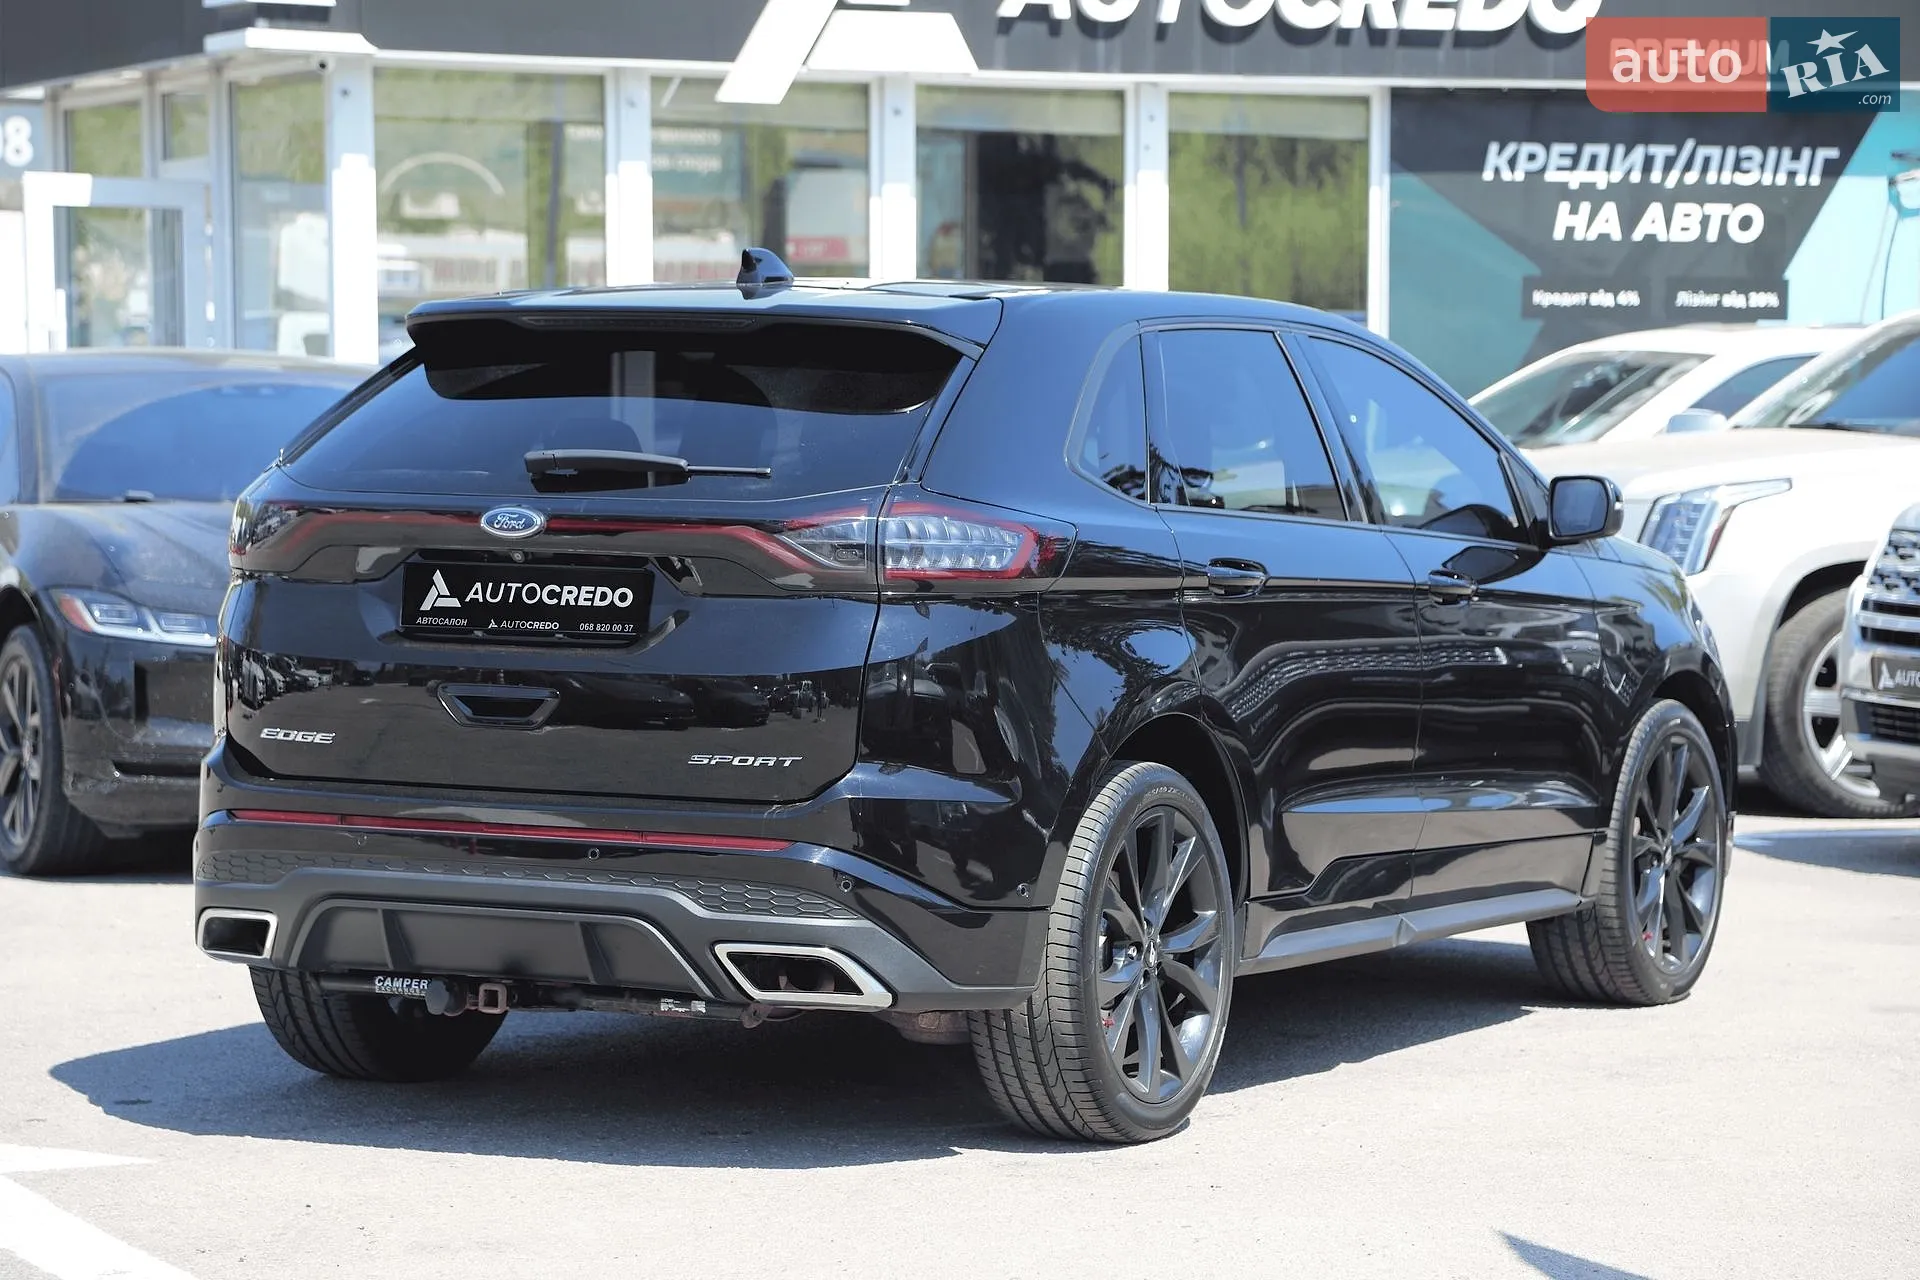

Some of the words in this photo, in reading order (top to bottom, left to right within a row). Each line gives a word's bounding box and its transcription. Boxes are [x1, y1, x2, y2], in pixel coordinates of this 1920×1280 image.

[1482, 138, 1841, 189] КРЕДИТ/ЛІЗІНГ
[1552, 201, 1623, 241] НА
[1631, 201, 1766, 244] АВТО
[494, 512, 525, 529] Ford
[464, 582, 634, 608] AUTOCREDO
[416, 616, 468, 627] АВТОСАЛОН
[500, 620, 560, 630] AUTOCREDO
[579, 622, 594, 631] 068
[595, 623, 610, 632] 820
[612, 624, 623, 632] 00
[623, 624, 634, 632] 37
[260, 727, 336, 744] EDGE
[687, 754, 803, 767] SPORT
[375, 975, 429, 990] CAMPER
